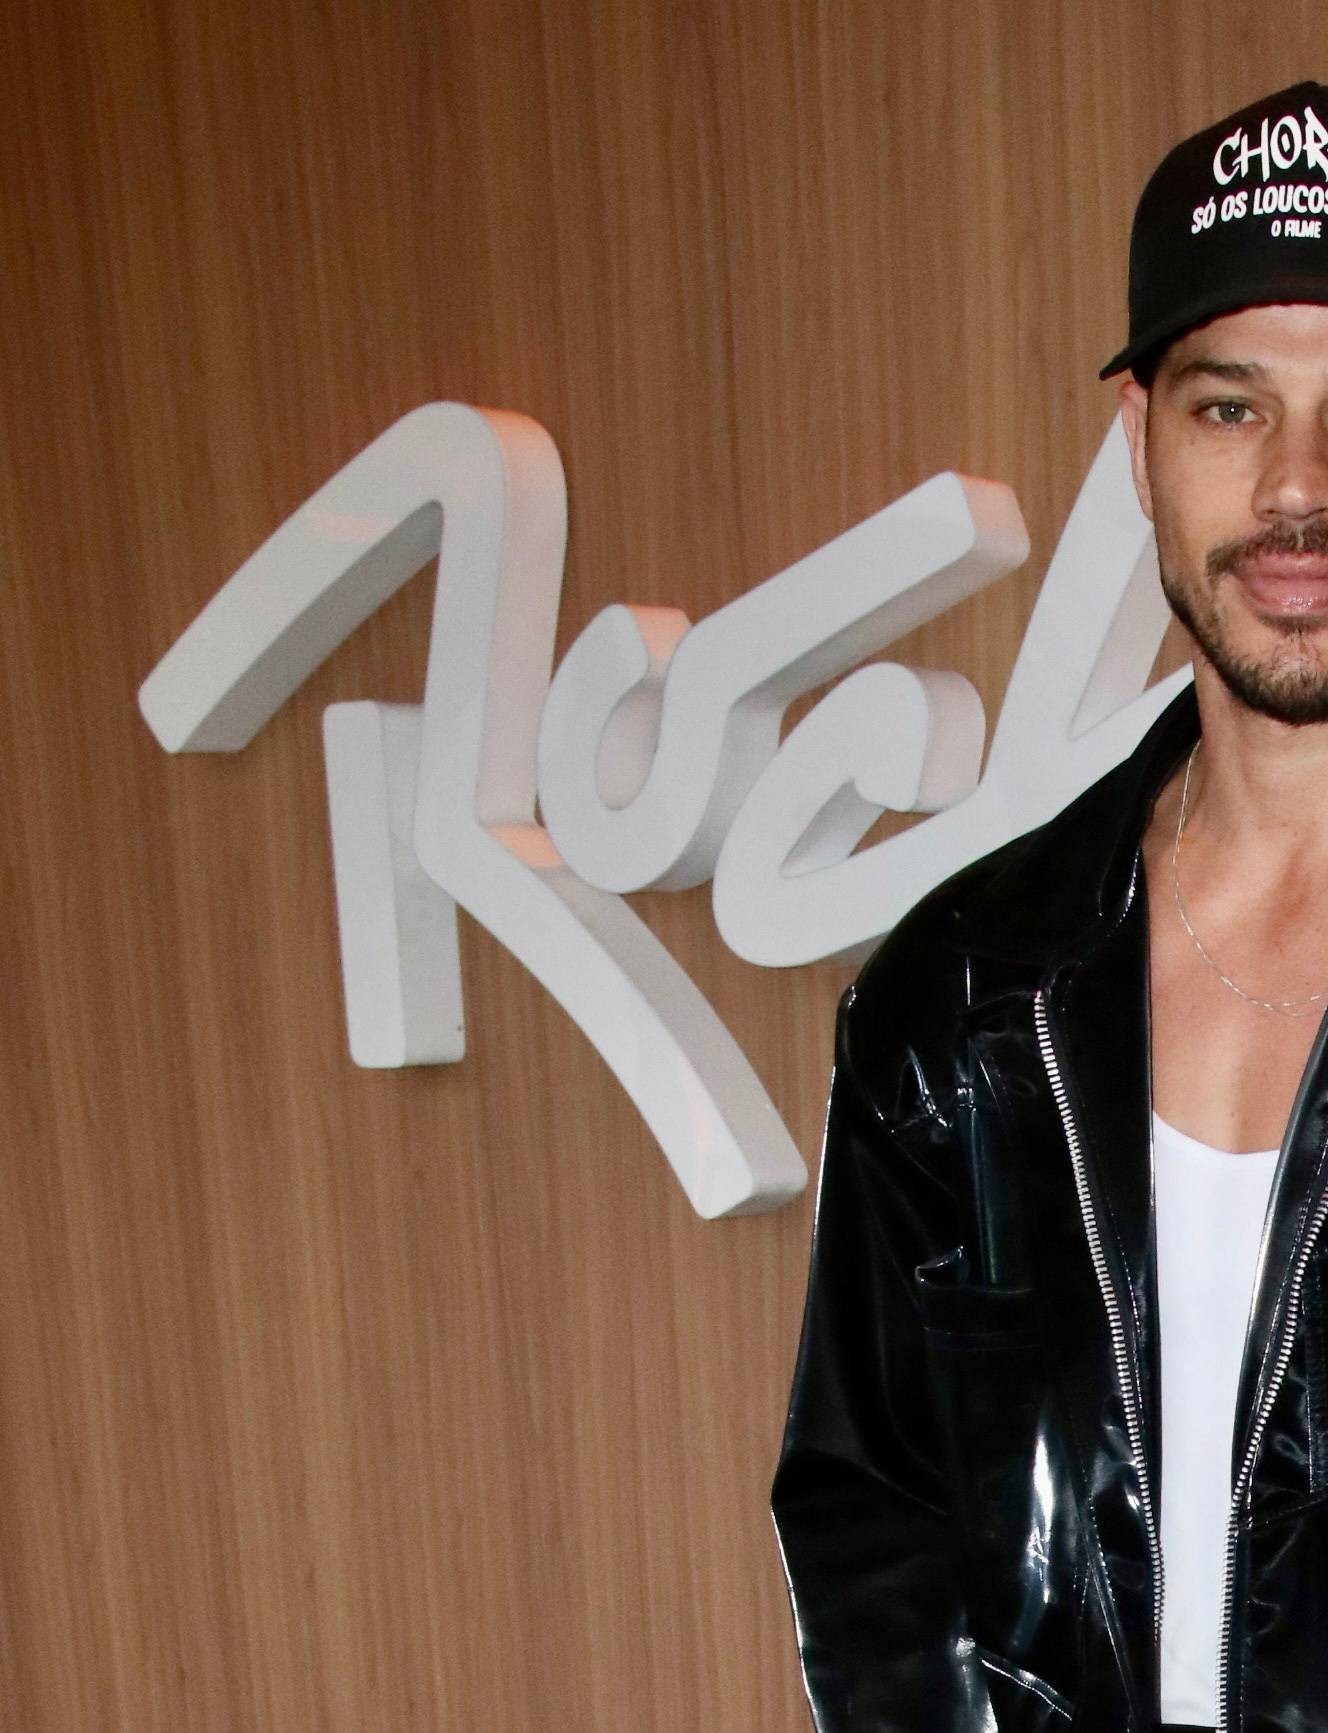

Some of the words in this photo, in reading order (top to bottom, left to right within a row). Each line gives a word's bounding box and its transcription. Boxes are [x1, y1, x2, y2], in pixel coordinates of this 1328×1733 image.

[1191, 196, 1216, 234] SÓ
[1221, 191, 1248, 222] OS
[1270, 219, 1281, 237] O
[1284, 220, 1322, 239] FILME
